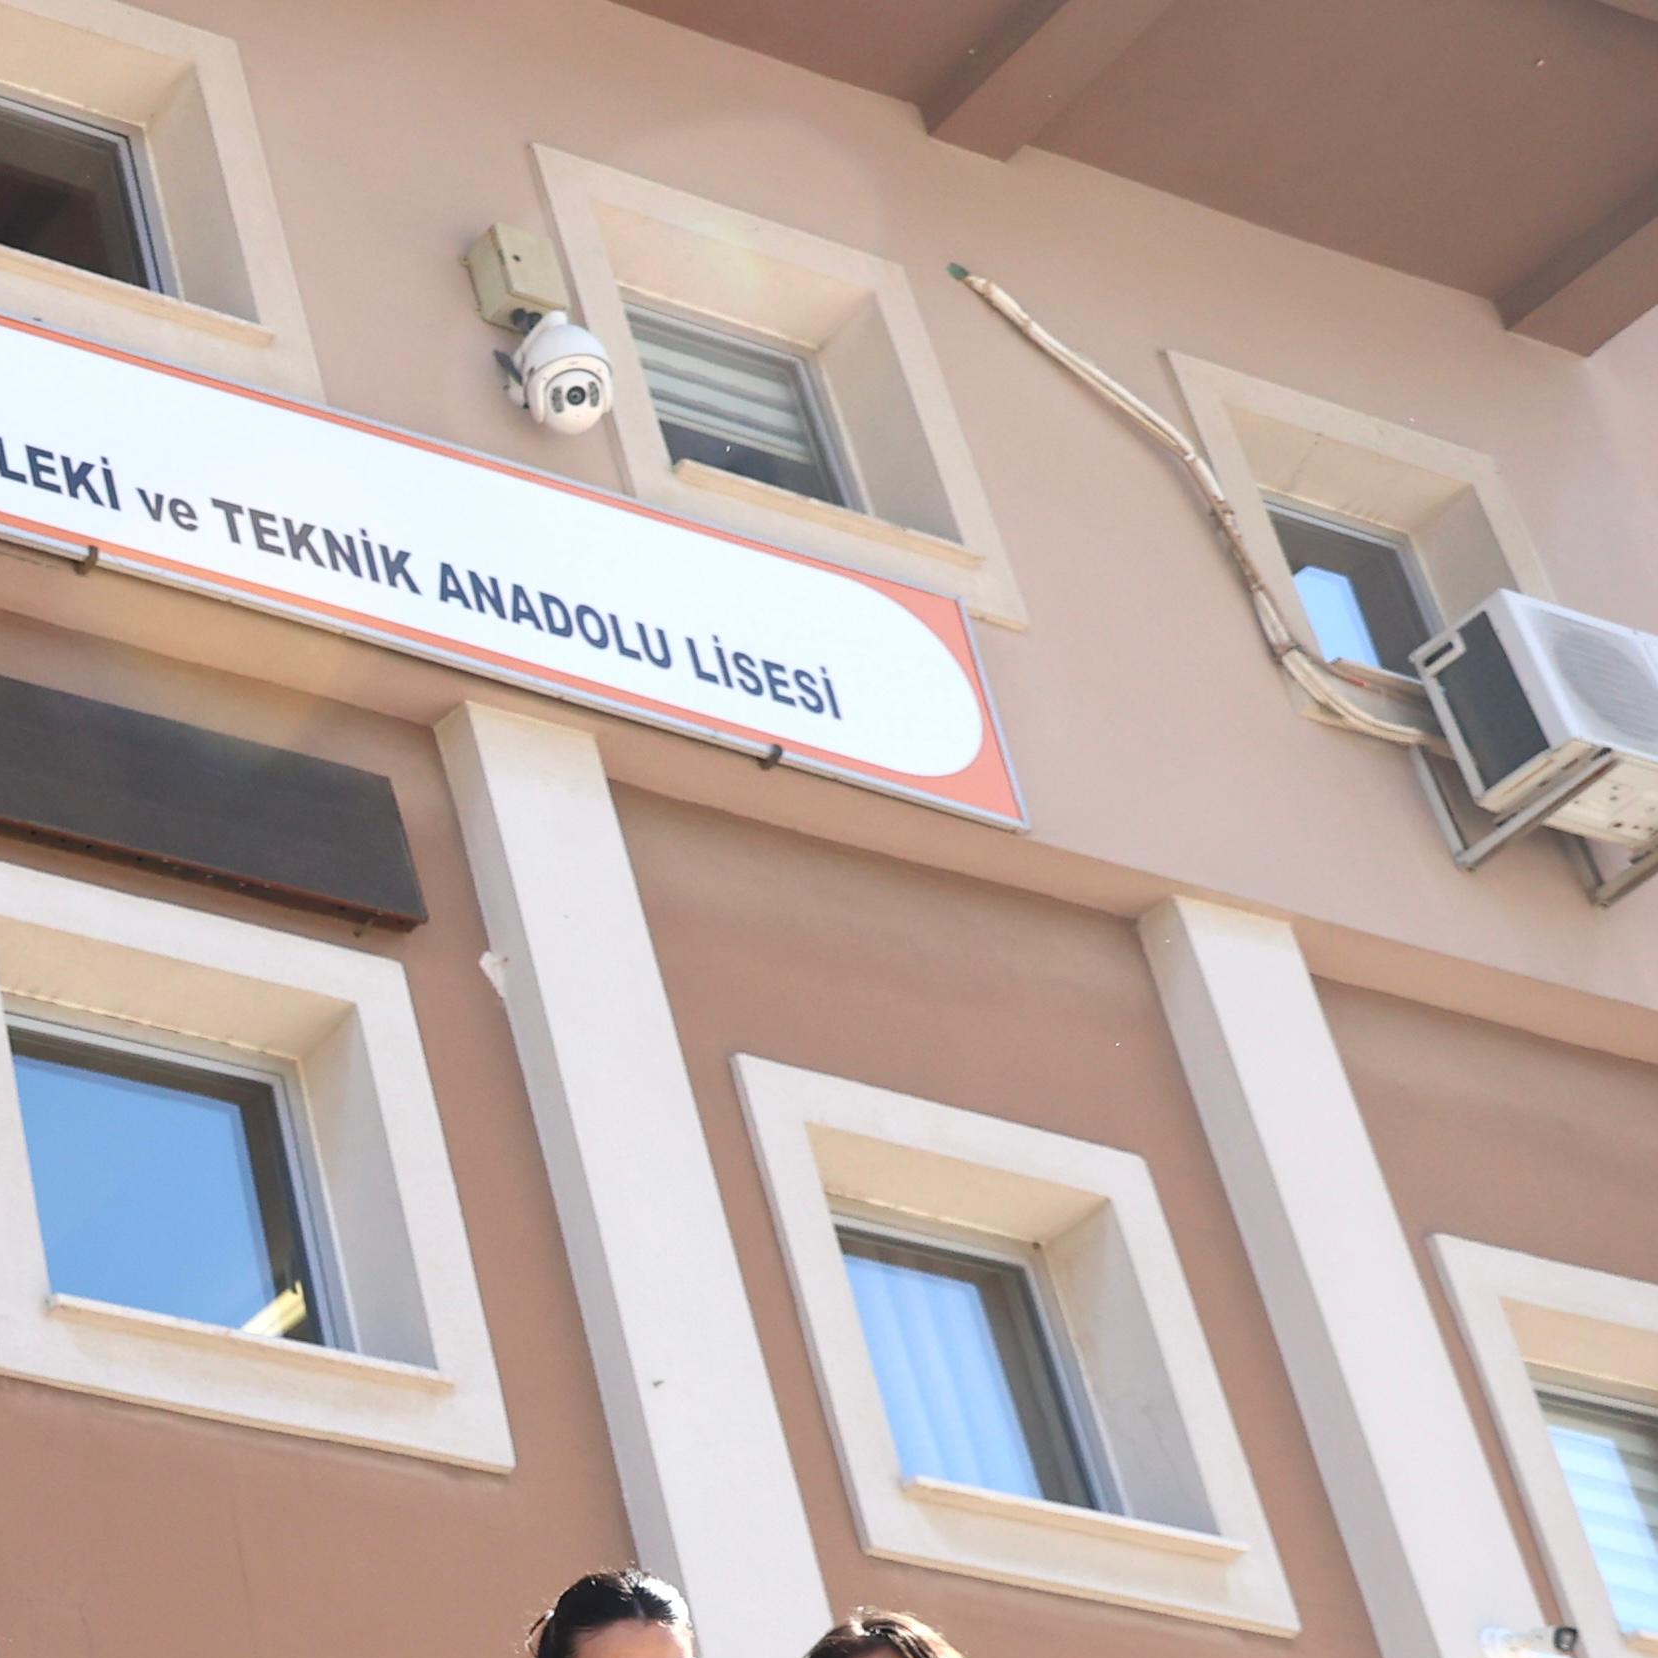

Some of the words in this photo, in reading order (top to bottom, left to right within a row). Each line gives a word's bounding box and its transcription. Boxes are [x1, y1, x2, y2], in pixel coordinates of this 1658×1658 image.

[137, 487, 199, 532] ve
[211, 498, 422, 595] TEKNİK
[438, 562, 673, 669] ANADOLU
[685, 634, 842, 720] LİSESİ
